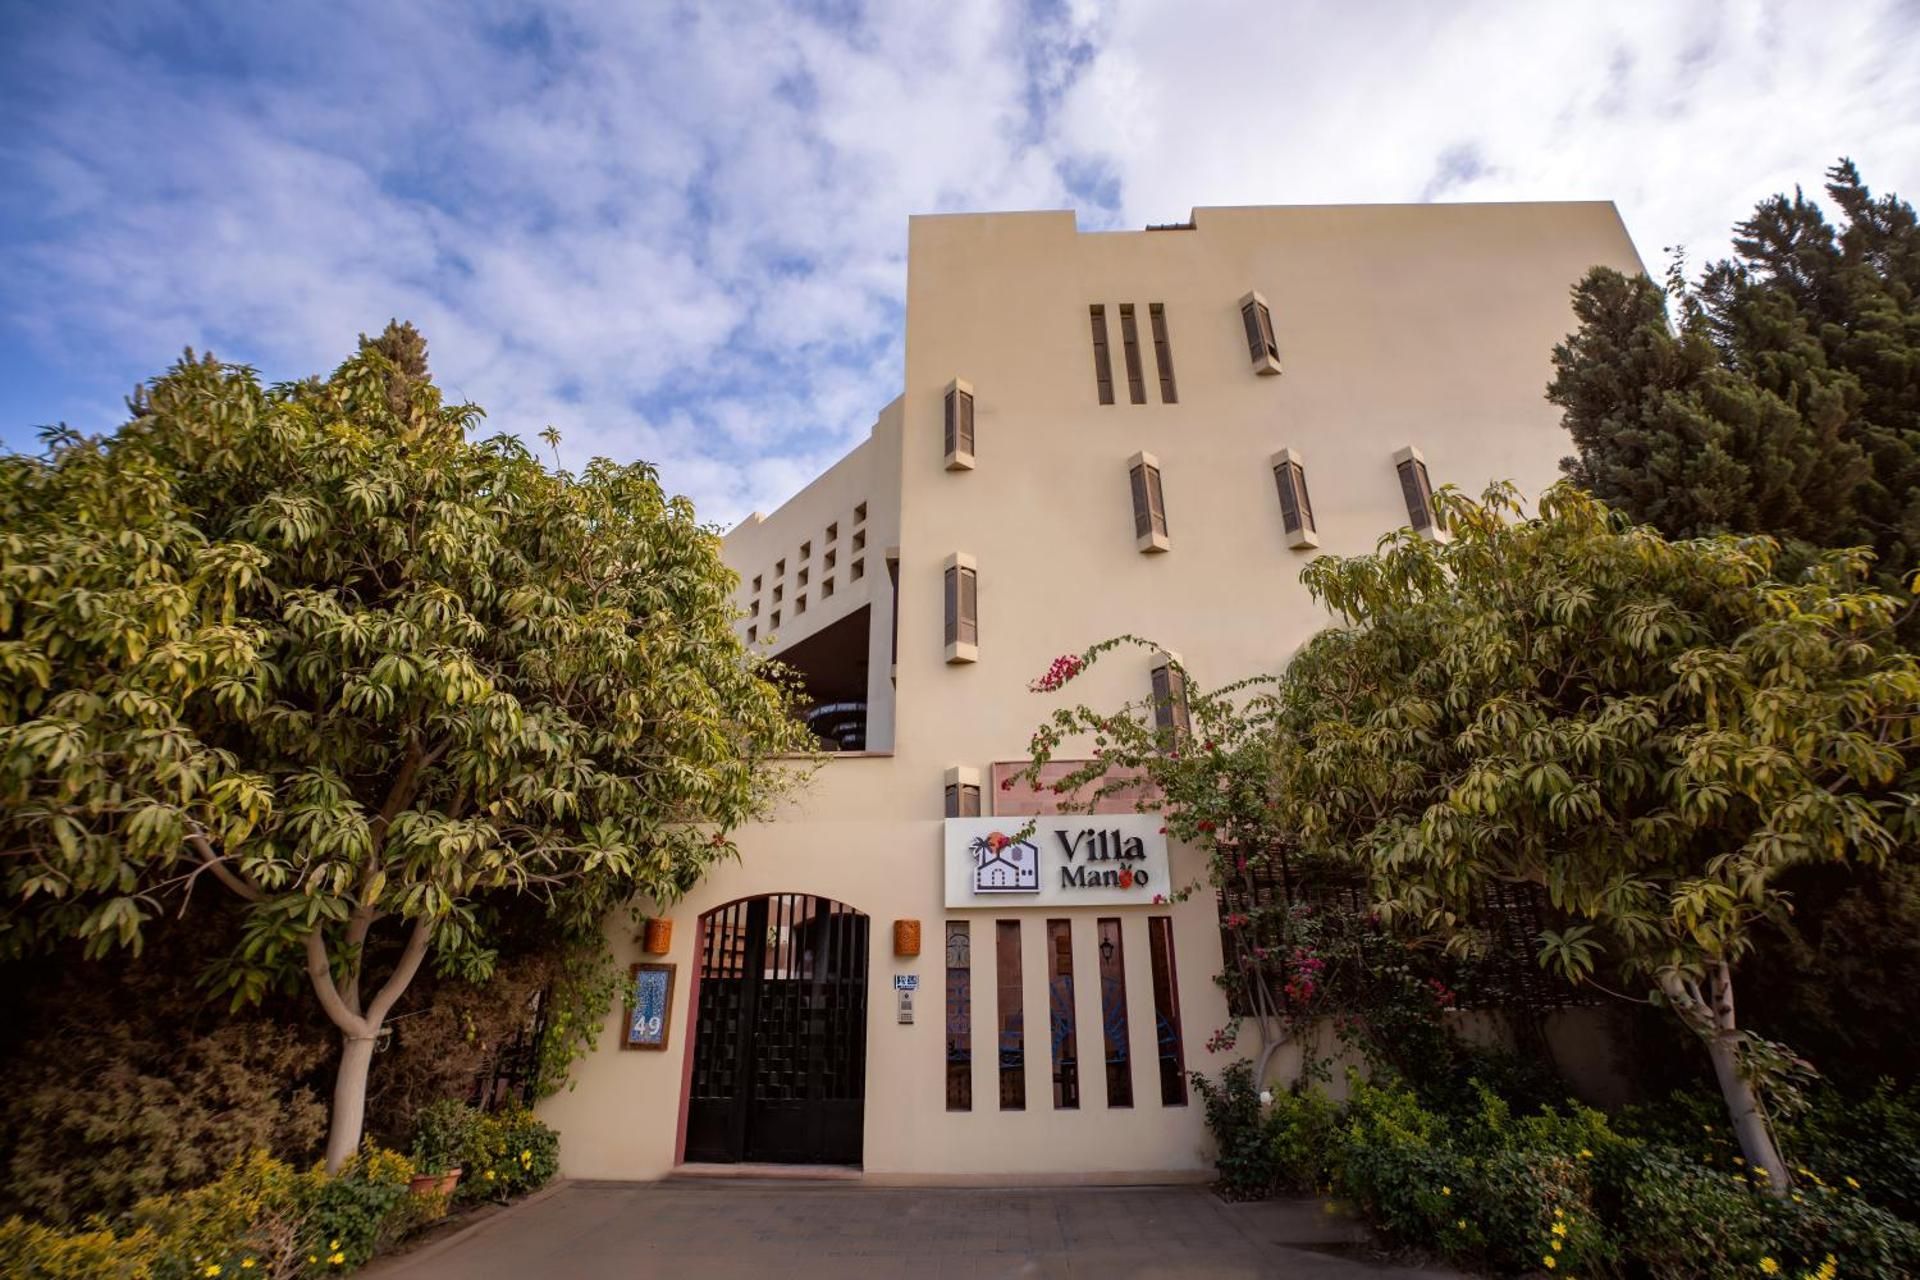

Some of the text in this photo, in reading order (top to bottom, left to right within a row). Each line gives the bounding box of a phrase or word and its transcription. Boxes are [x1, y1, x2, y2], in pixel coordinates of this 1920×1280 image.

[1054, 828, 1146, 862] Villa
[1060, 863, 1149, 889] Mano
[634, 1016, 660, 1035] 49
